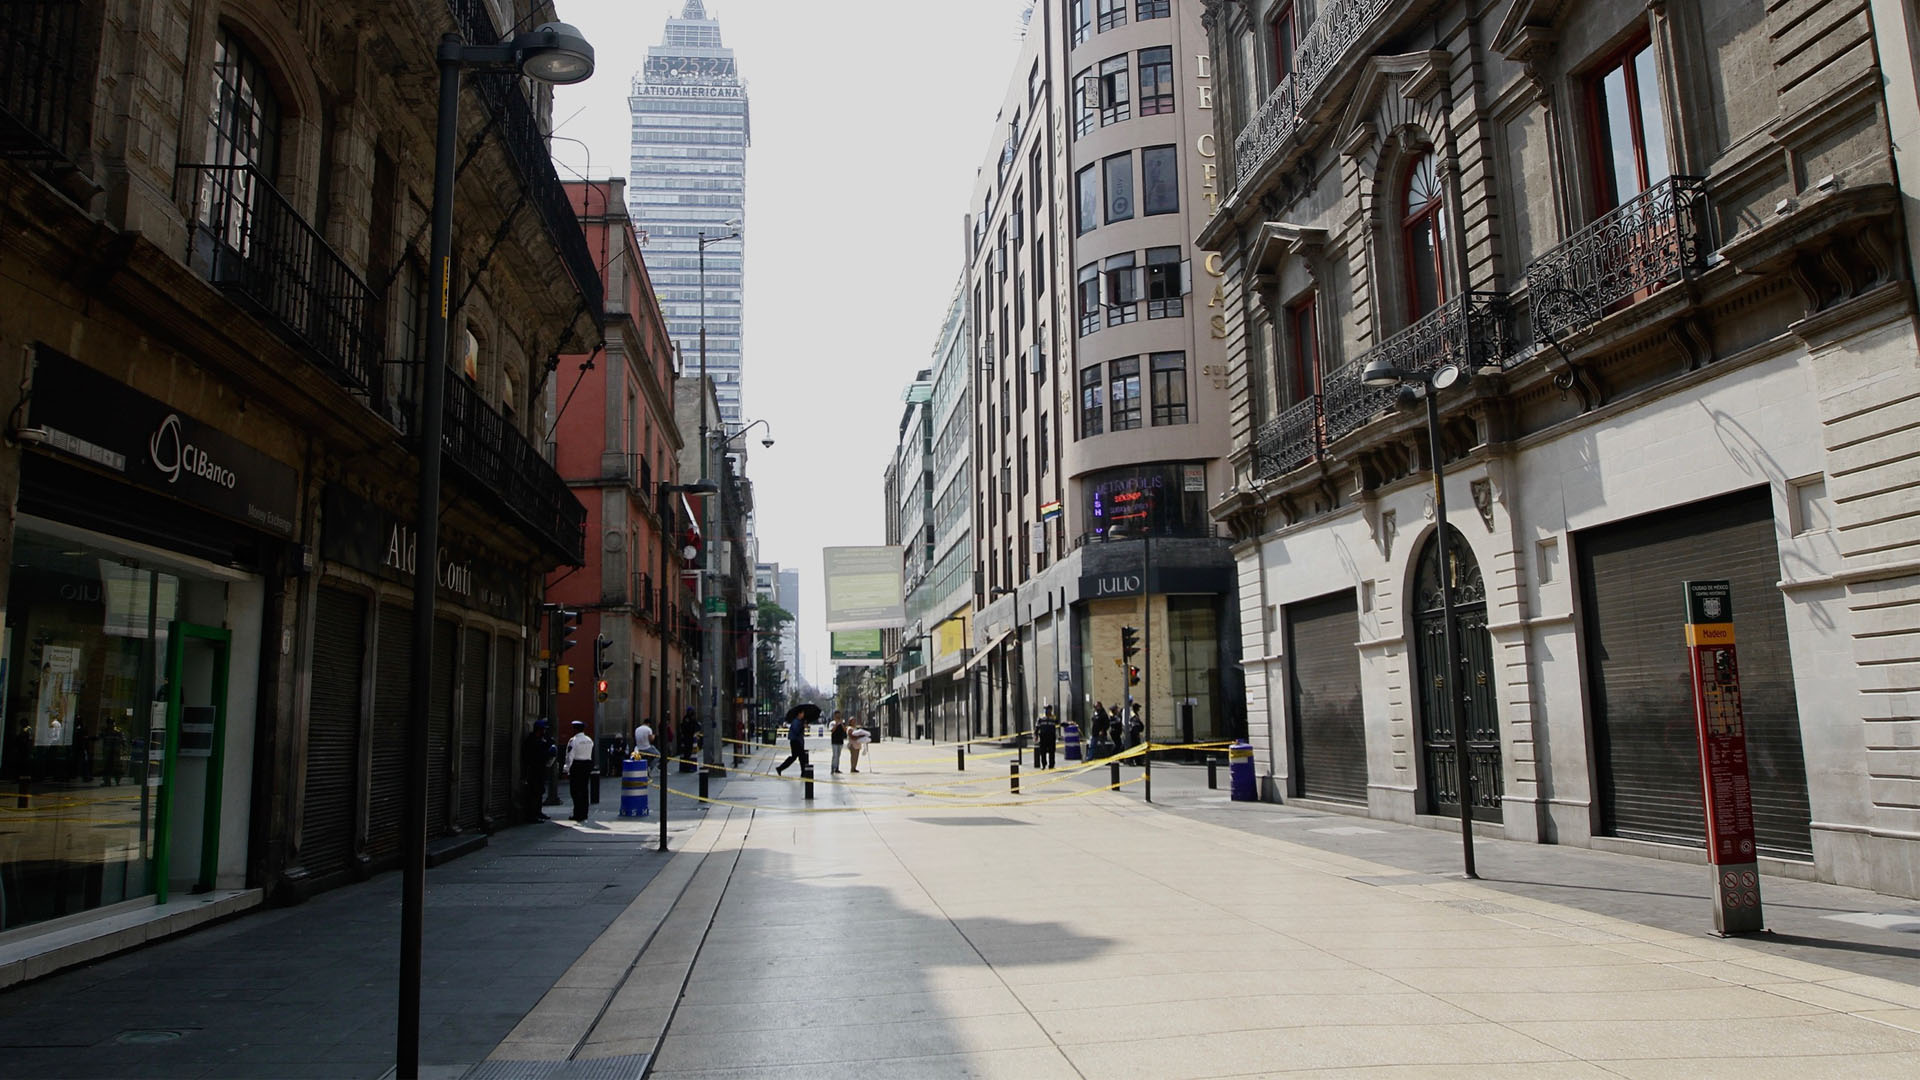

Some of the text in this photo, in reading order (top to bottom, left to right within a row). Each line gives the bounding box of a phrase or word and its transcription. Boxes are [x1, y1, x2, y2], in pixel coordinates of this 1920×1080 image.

[638, 86, 739, 97] LATINOAMERICANA
[181, 443, 236, 490] CIBanco
[386, 520, 417, 576] Ald
[436, 545, 472, 597] Conti
[1096, 575, 1140, 595] JULIO
[1702, 629, 1727, 638] Madero
